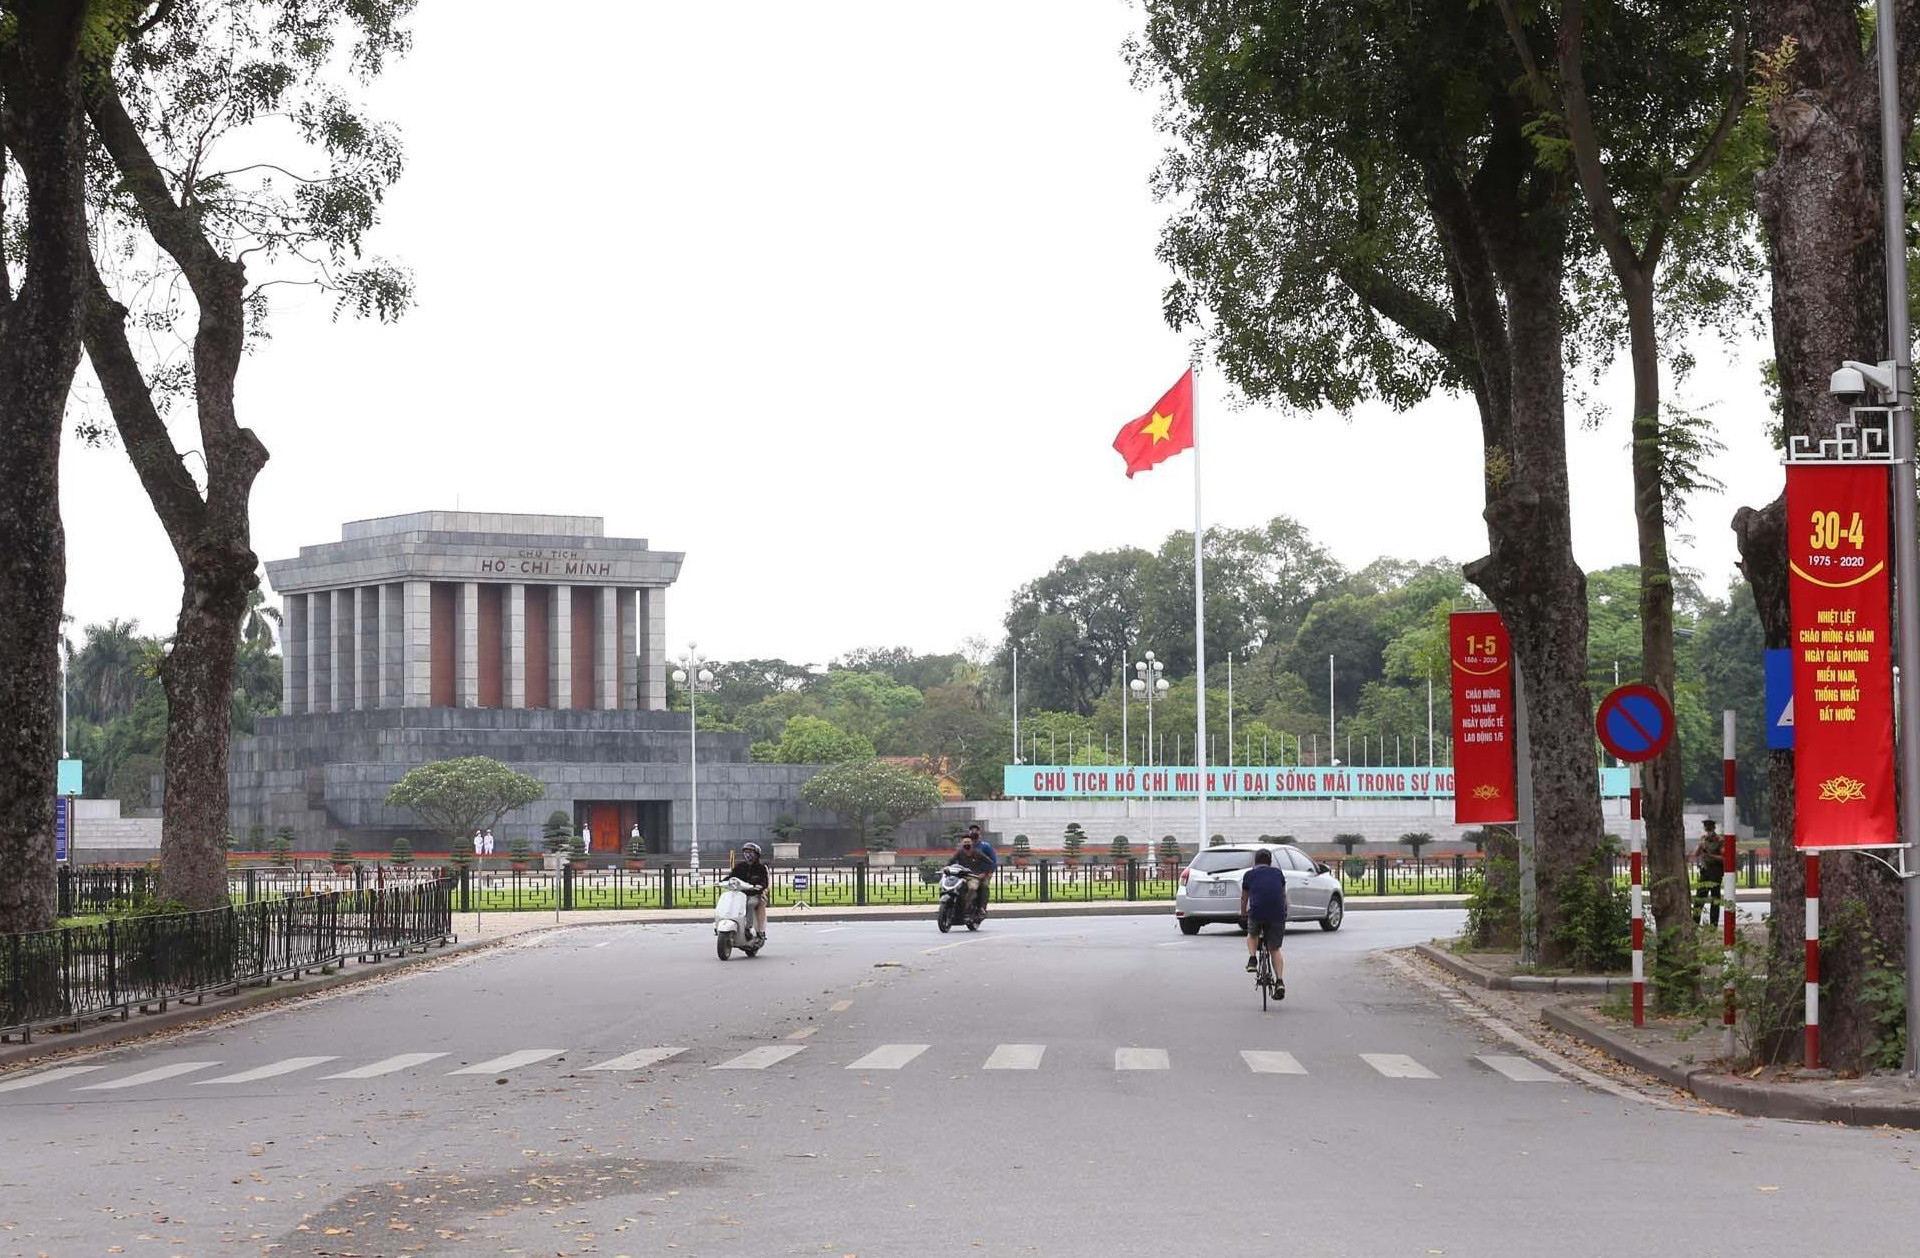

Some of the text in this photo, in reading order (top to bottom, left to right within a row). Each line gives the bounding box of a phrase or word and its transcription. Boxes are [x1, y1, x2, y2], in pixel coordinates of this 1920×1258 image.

[1810, 510, 1864, 550] 30-4
[1808, 555, 1831, 566] 1975
[1840, 556, 1865, 567] 2020
[1817, 608, 1856, 626] NHIỆT LIỆT
[1799, 628, 1875, 643] CHÀO MỪNG 45 NĂM
[1466, 635, 1496, 656] 1-5
[1804, 645, 1869, 663] NGÀY GIẢI PHÓNG
[1837, 669, 1858, 683] NAM,
[1814, 685, 1860, 702] THỐNG NHẤT
[1819, 705, 1856, 721] ĐẤT NƯỚC
[1464, 732, 1476, 743] LAO
[1034, 767, 1066, 792] CHỦ
[1072, 772, 1108, 795] TỊCH
[1115, 767, 1136, 792] HỒ
[1142, 769, 1168, 792] CHÍ
[1223, 769, 1237, 792] VĨ
[1244, 772, 1269, 795] ĐẠI
[1276, 768, 1316, 792] SỐNG
[1323, 770, 1351, 792] MÃI
[1357, 773, 1405, 792] TRONG
[1411, 771, 1430, 795] SỰ
